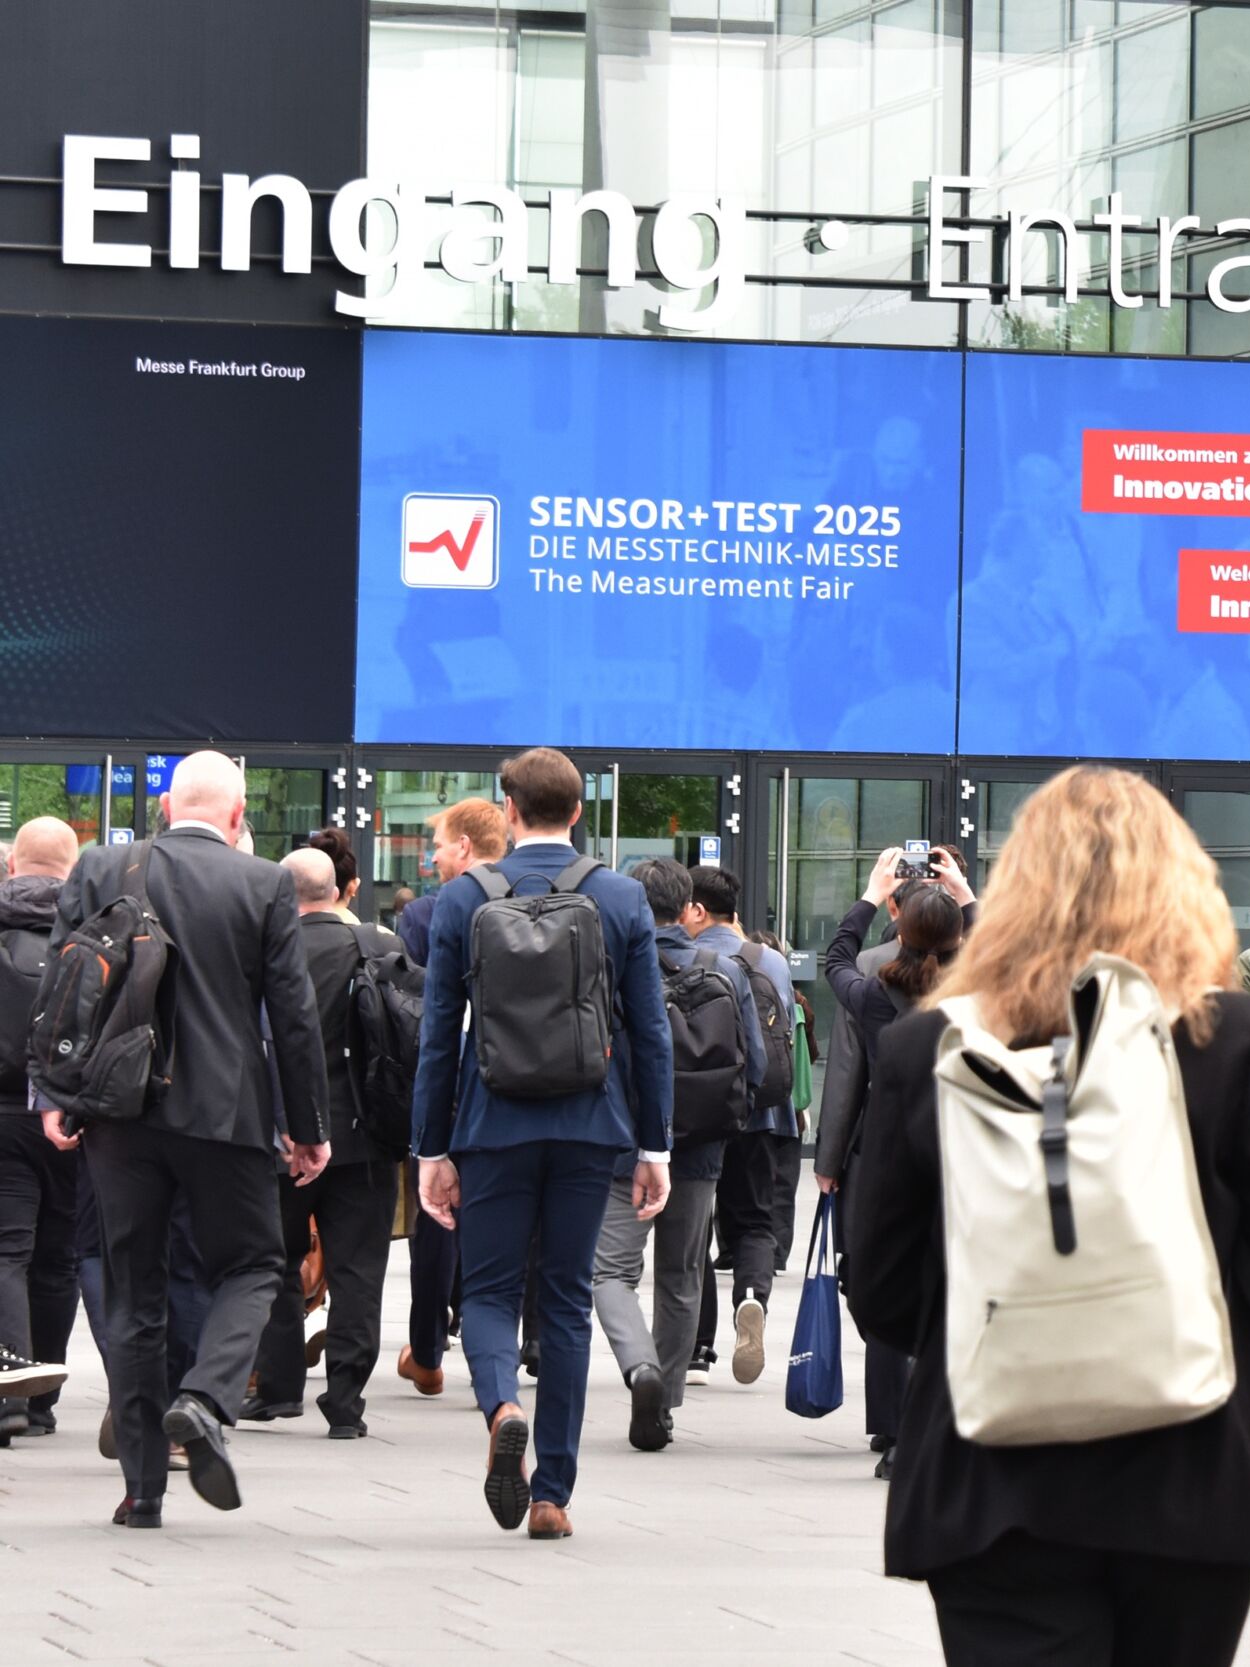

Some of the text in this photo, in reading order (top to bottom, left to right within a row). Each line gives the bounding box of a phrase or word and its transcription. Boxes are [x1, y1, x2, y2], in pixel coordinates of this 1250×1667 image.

[61, 133, 746, 330] Eingang
[136, 357, 306, 382] Messe Frankfurt Group
[1113, 443, 1238, 464] Willkommen
[529, 496, 901, 537] SENSOR+TEST 2025
[529, 535, 900, 568] DIE MESSTECHNIK-MESSE
[529, 568, 854, 600] The Measurement Fair
